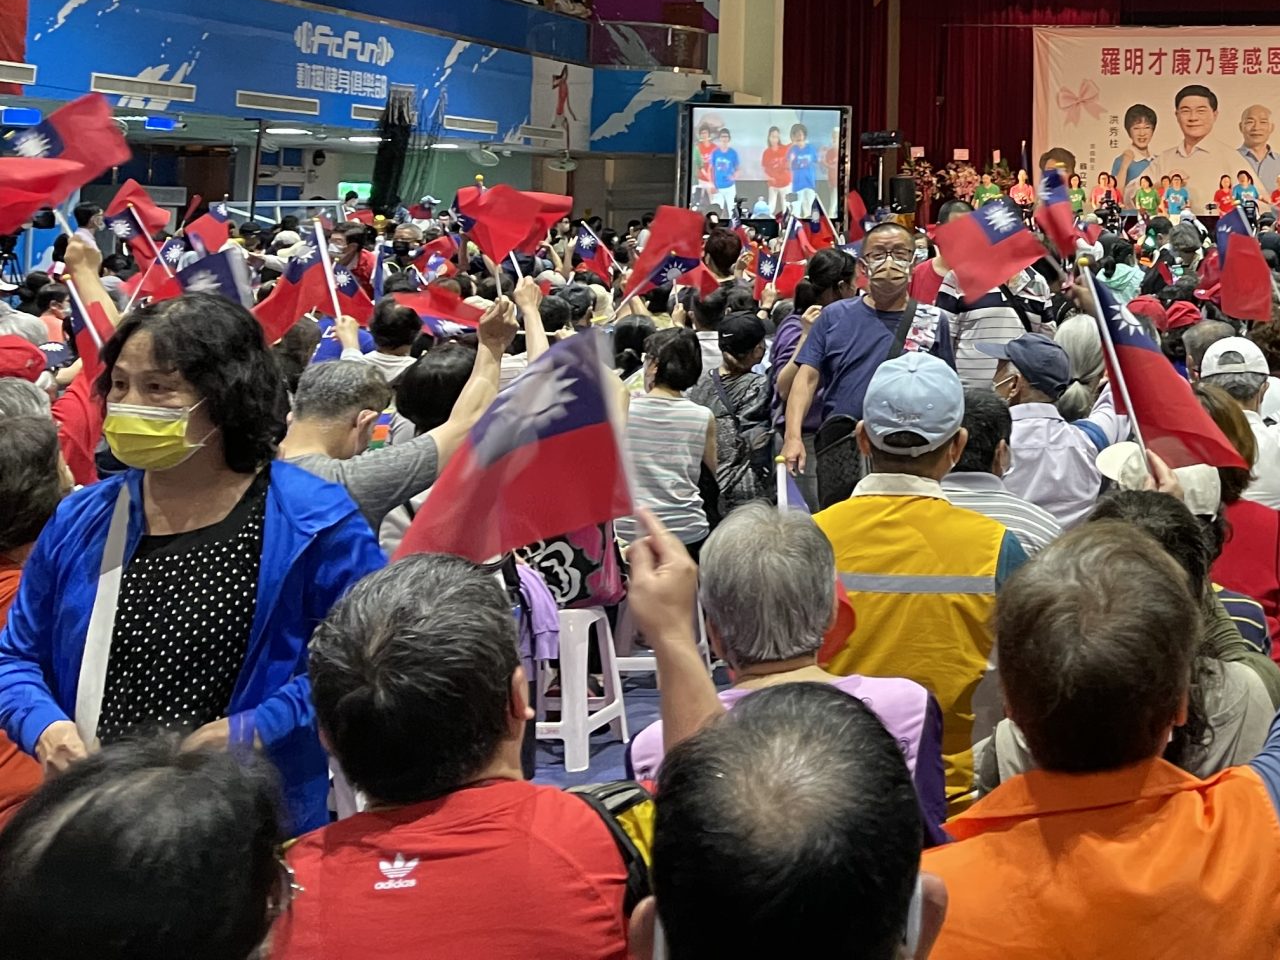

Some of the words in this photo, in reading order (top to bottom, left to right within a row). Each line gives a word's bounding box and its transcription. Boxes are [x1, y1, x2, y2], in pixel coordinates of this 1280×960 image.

[1109, 115, 1119, 149] 洪秀柱
[373, 878, 417, 891] adidas
